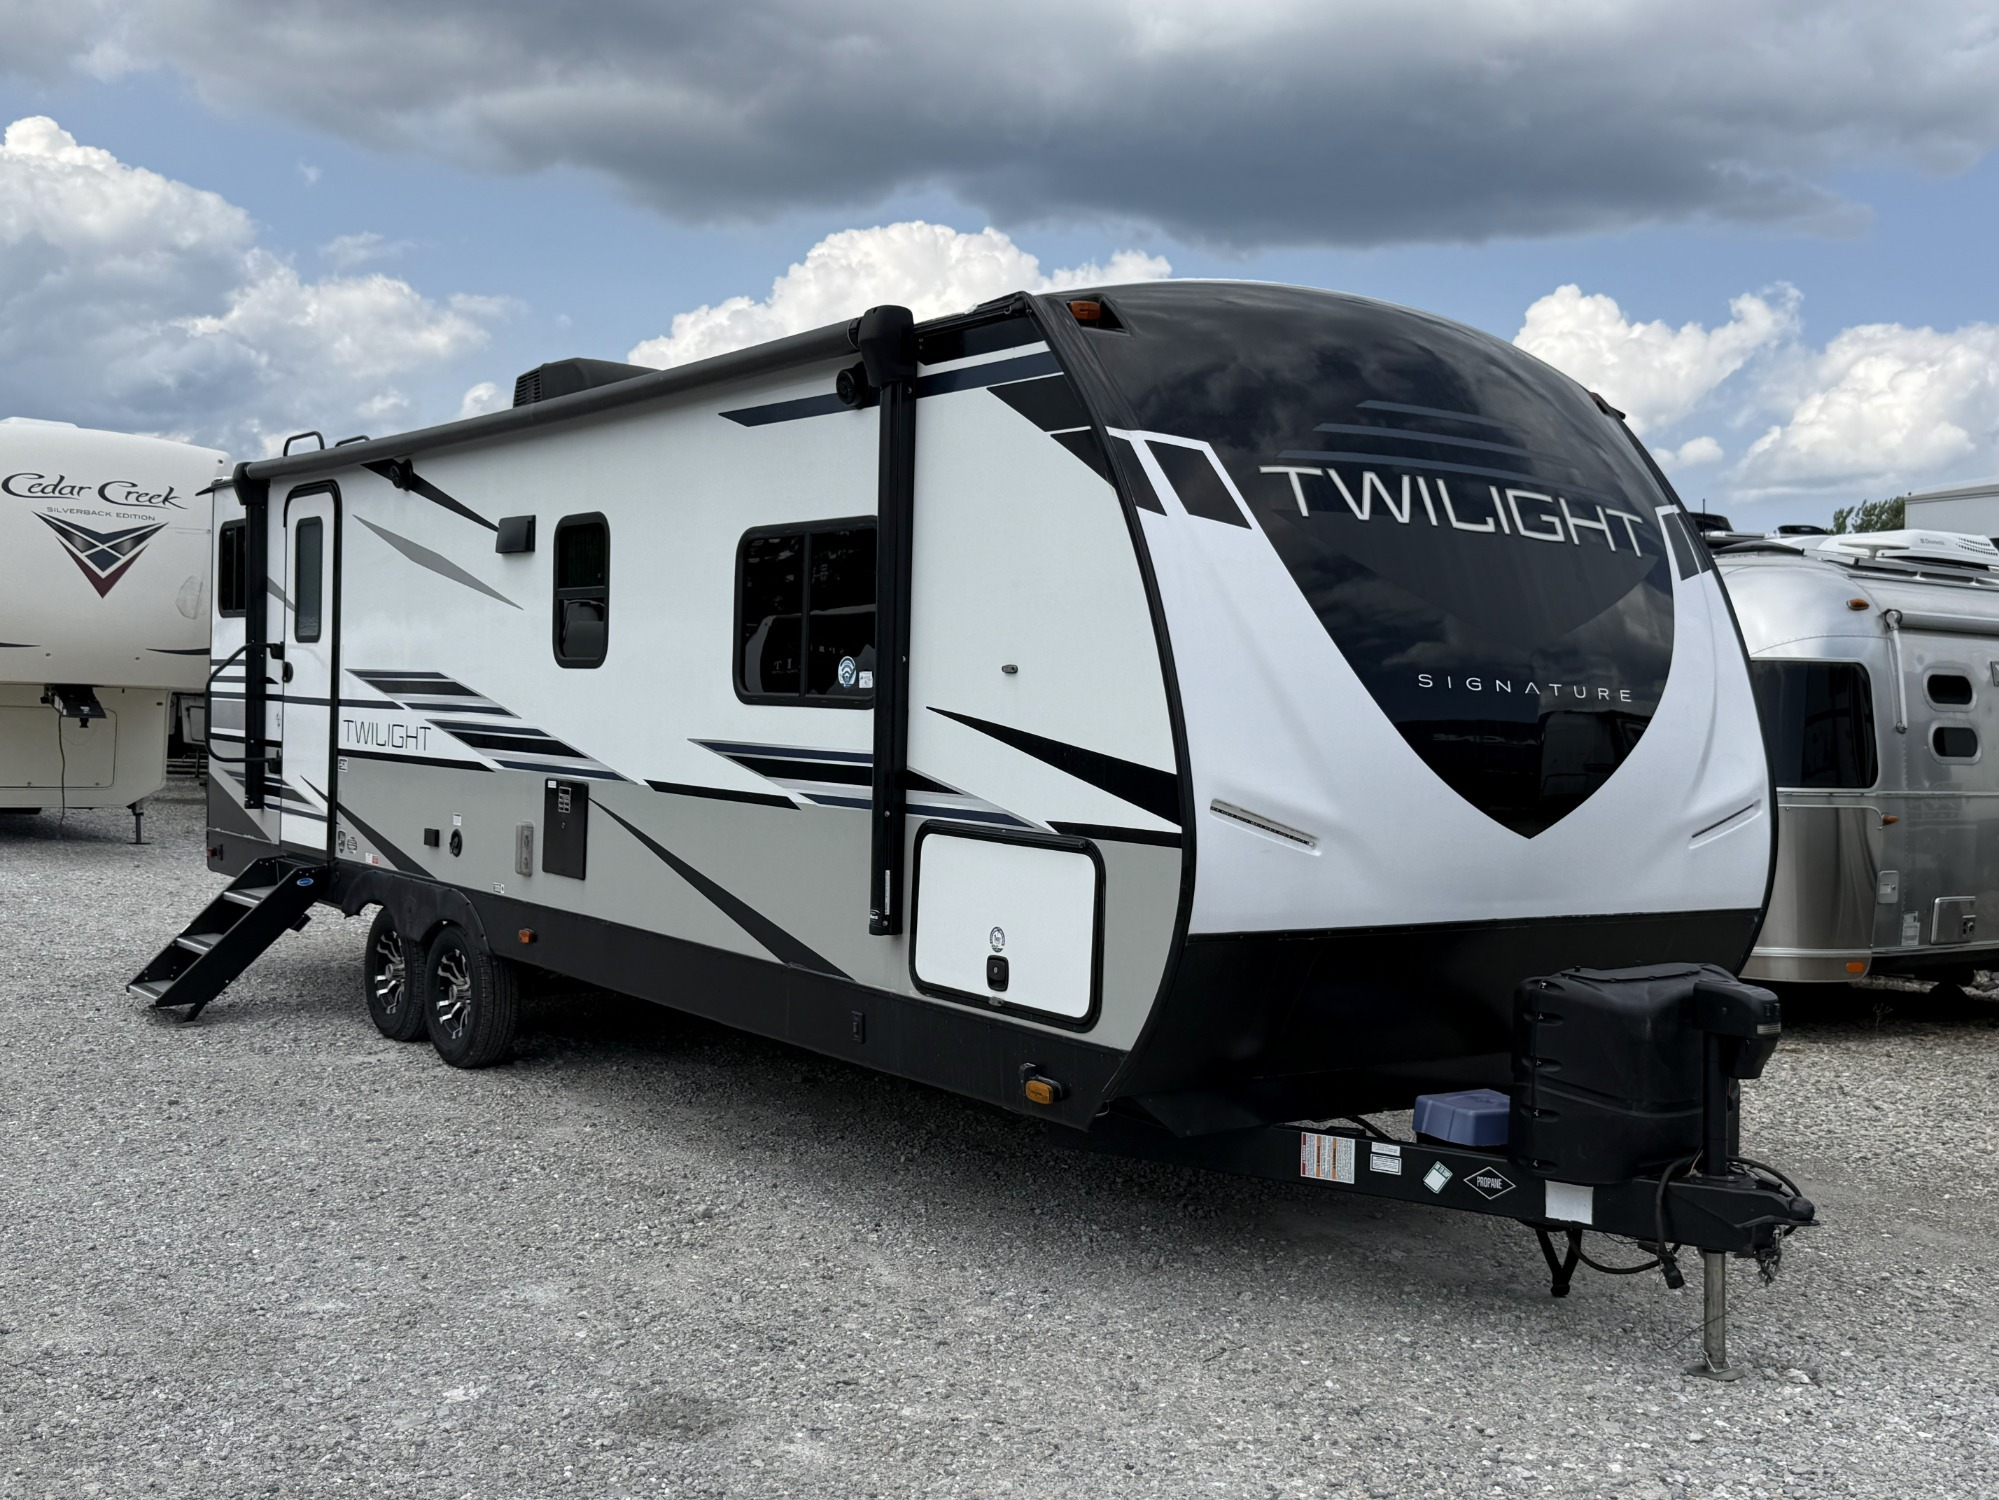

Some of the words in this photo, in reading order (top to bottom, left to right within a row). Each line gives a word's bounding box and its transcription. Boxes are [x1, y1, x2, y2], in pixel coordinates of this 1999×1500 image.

[1, 472, 92, 501] Cedar
[97, 480, 189, 511] Creek
[46, 506, 112, 517] SILVERBACK
[115, 512, 156, 522] EDITION
[1259, 464, 1644, 558] TWILIGHT
[1418, 673, 1633, 703] SIGNATURE
[343, 719, 432, 752] TWILIGHT
[1476, 1175, 1503, 1190] PROPANE
